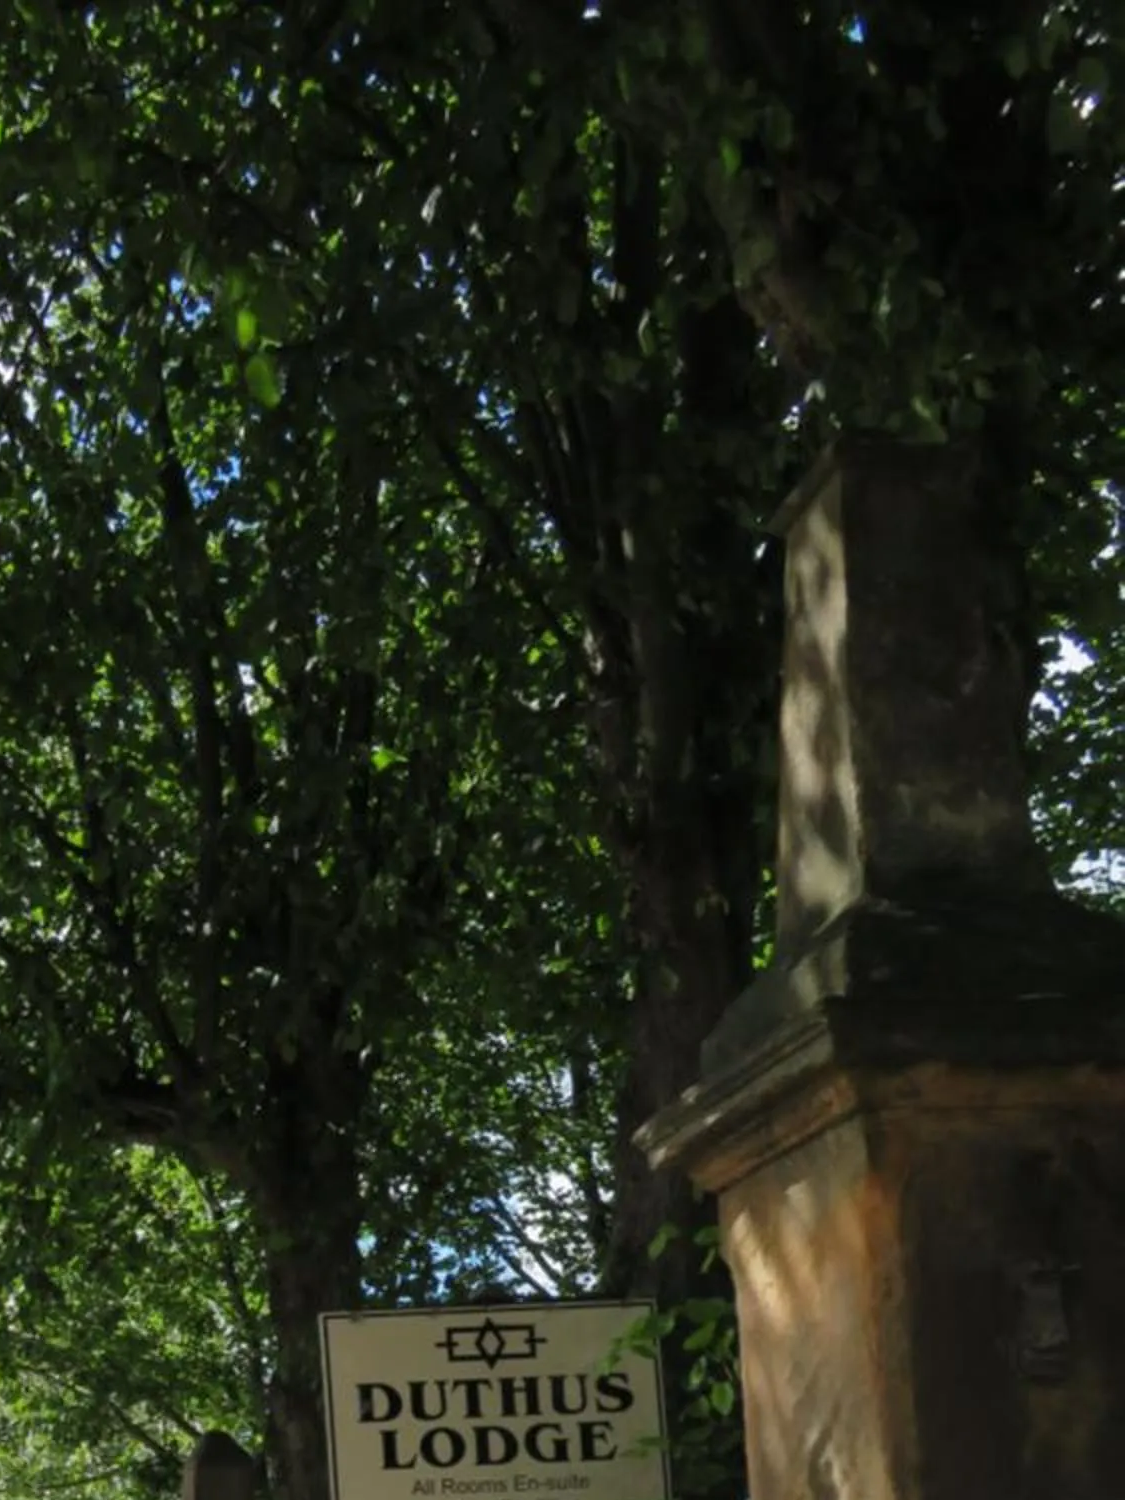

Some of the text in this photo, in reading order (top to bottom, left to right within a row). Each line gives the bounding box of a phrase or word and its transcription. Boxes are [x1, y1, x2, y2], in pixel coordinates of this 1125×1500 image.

[356, 1372, 635, 1424] DUTHUS
[379, 1420, 619, 1470] LODGE
[411, 1474, 591, 1496] All Rooms En-suite
